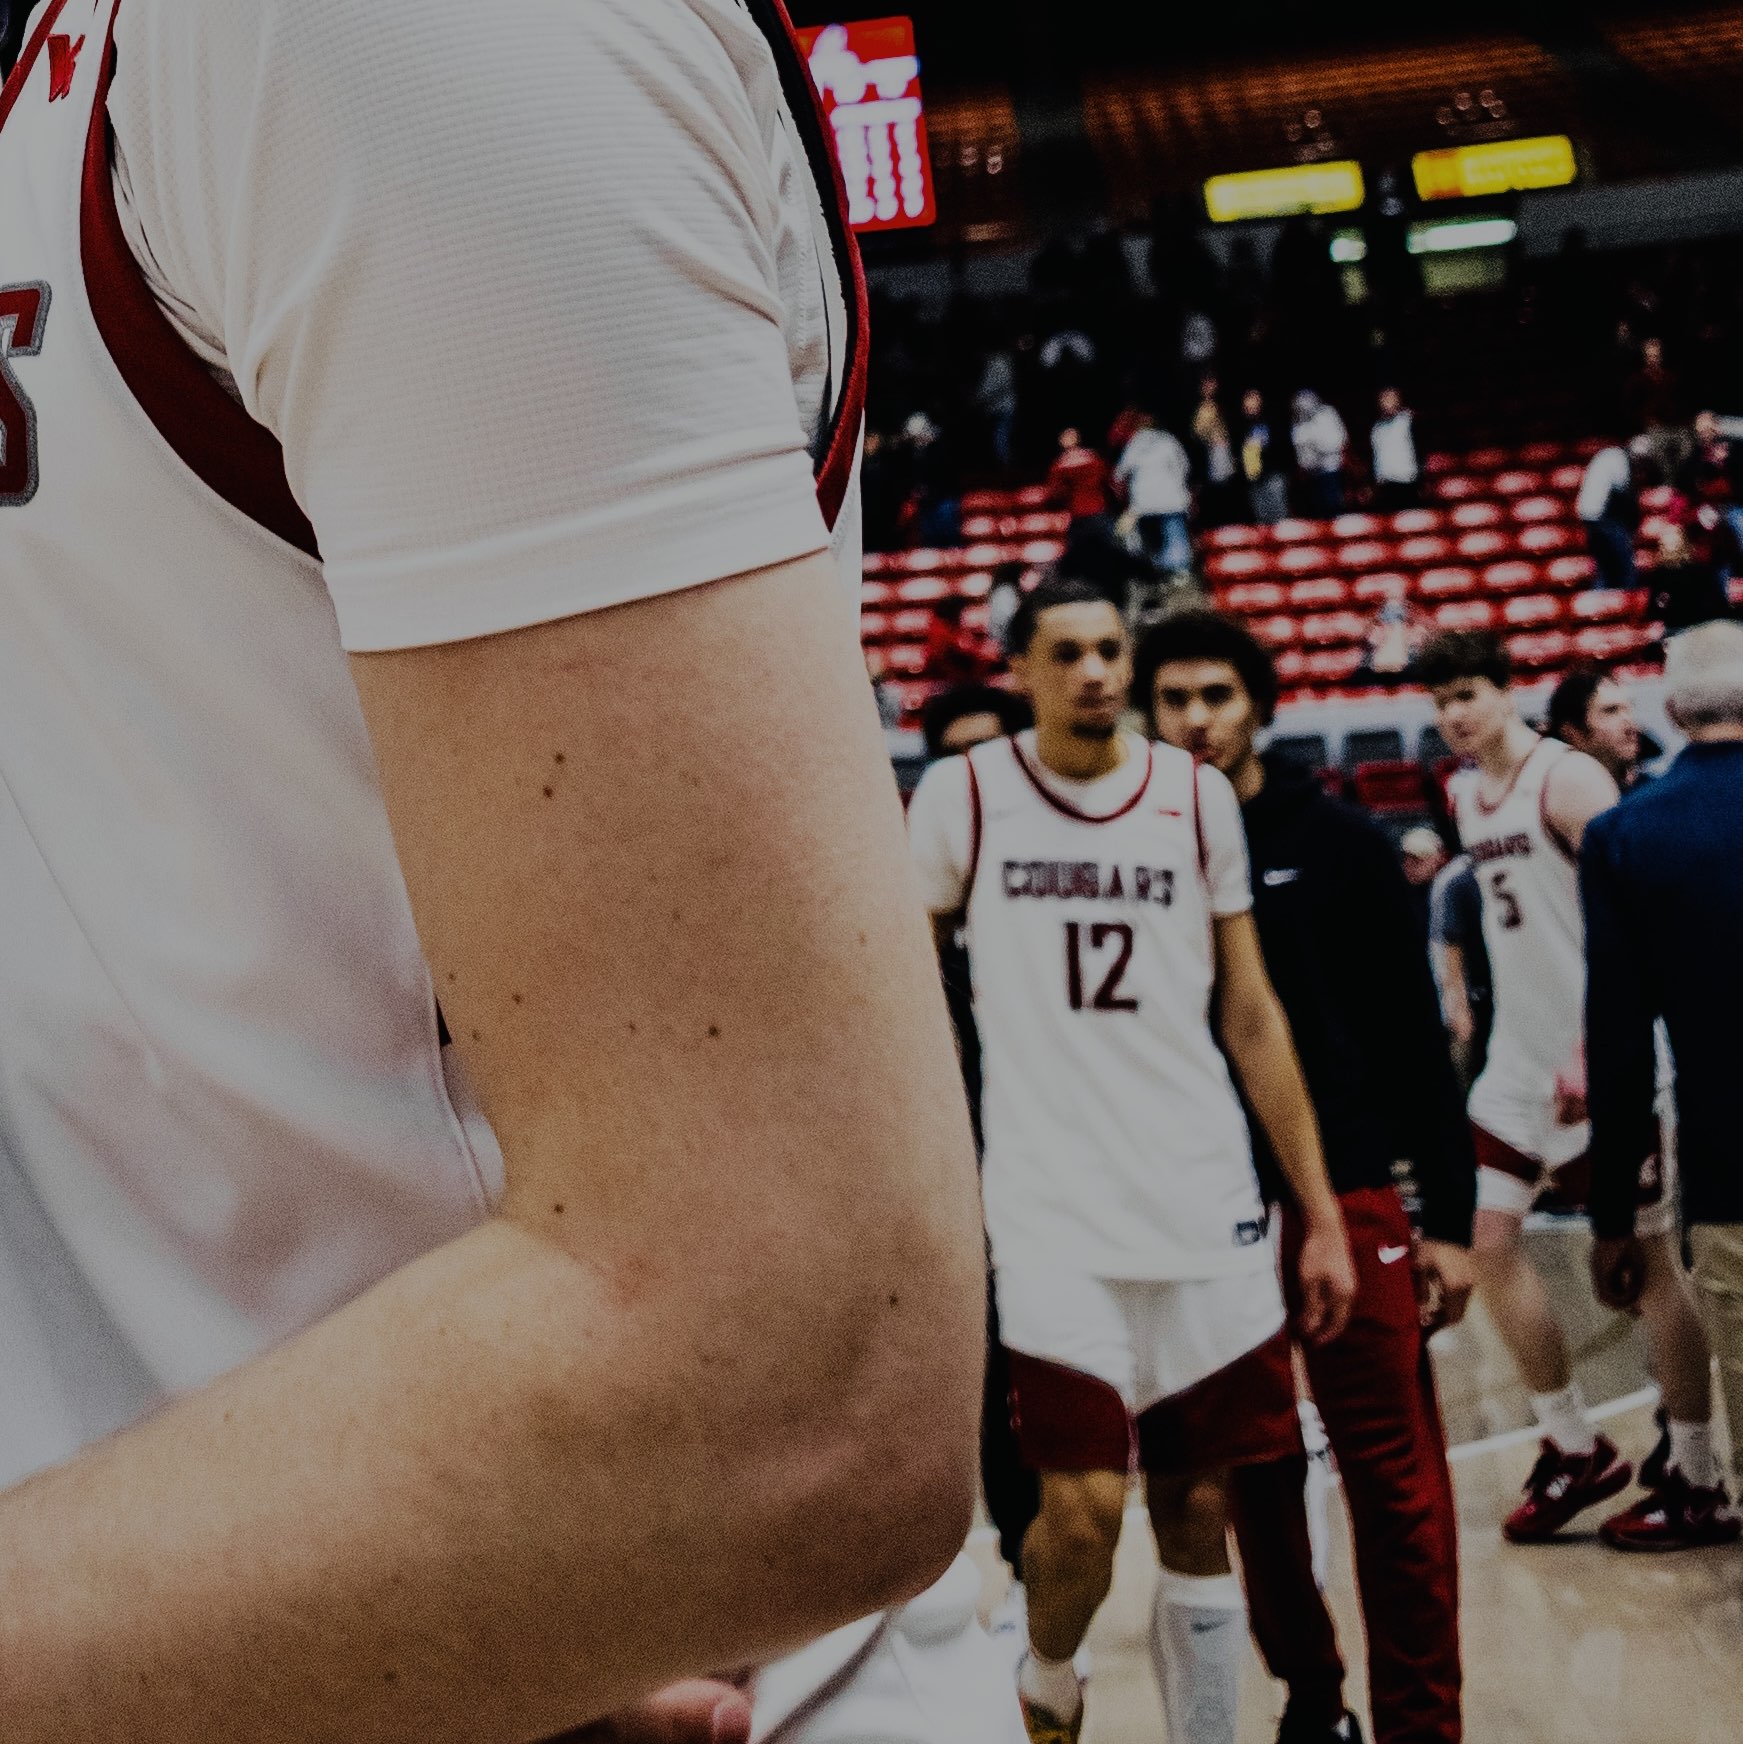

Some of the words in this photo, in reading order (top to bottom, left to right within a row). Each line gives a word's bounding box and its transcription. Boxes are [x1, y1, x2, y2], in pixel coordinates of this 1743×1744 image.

[1002, 860, 1177, 909] COUGARS
[1490, 871, 1524, 930] 5
[1064, 920, 1140, 1012] 12
